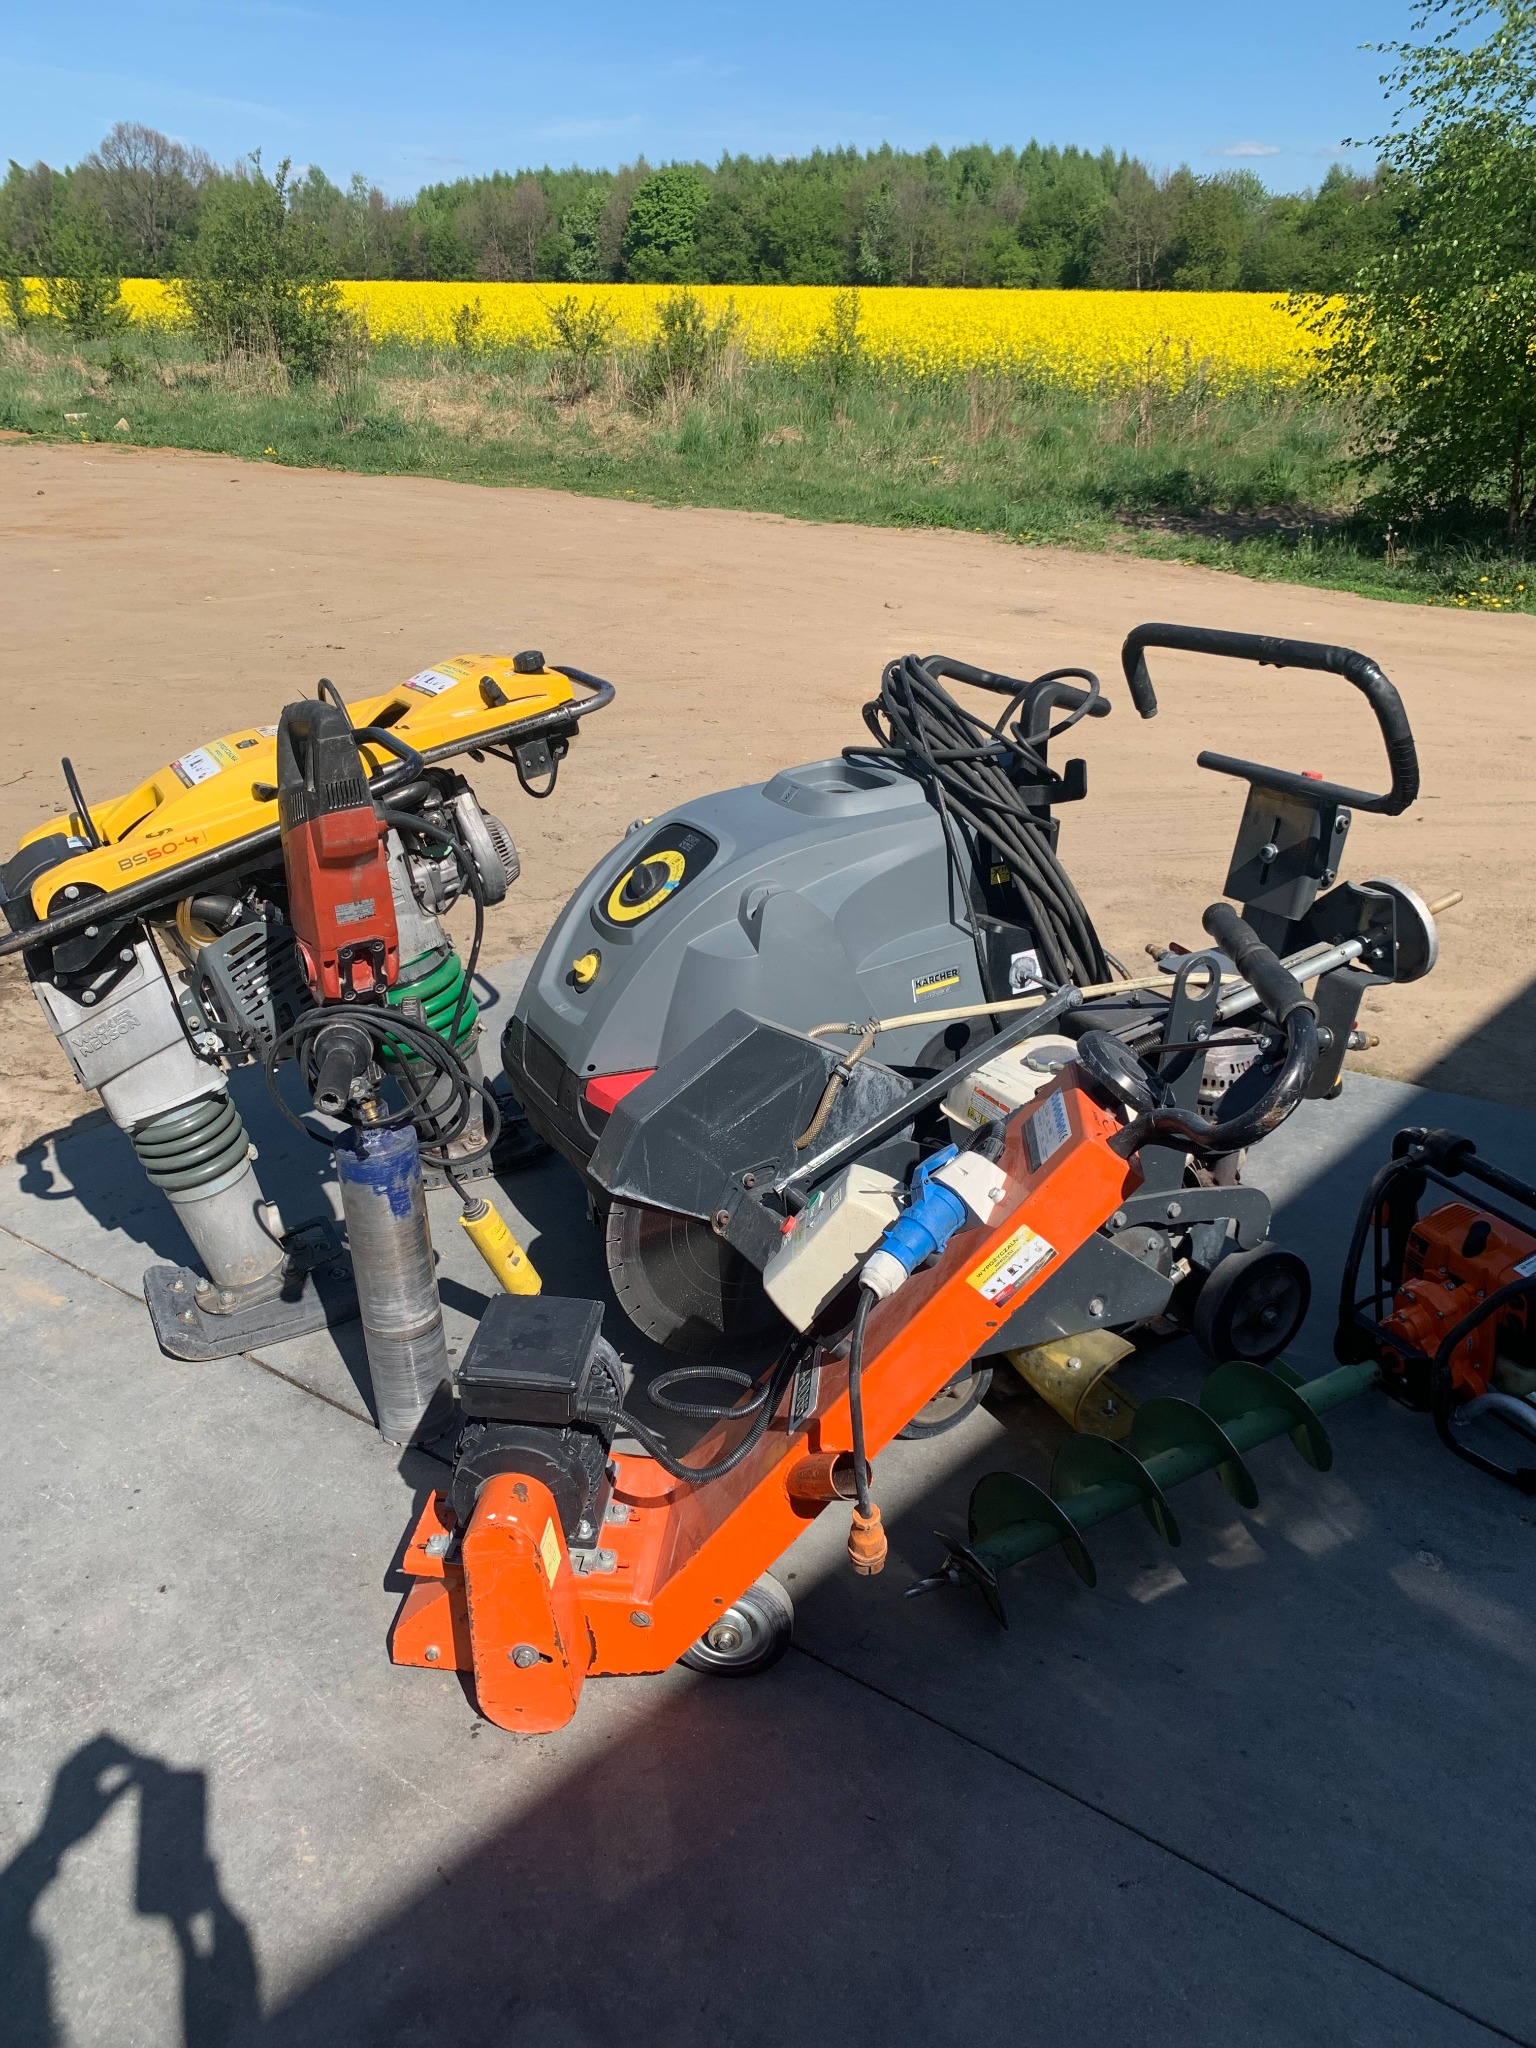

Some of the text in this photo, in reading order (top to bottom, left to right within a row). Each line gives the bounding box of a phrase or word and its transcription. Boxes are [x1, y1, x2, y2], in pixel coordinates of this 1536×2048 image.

[118, 836, 199, 871] BS50-4
[71, 1008, 135, 1047] WACKER
[80, 1017, 141, 1057] NEUSON
